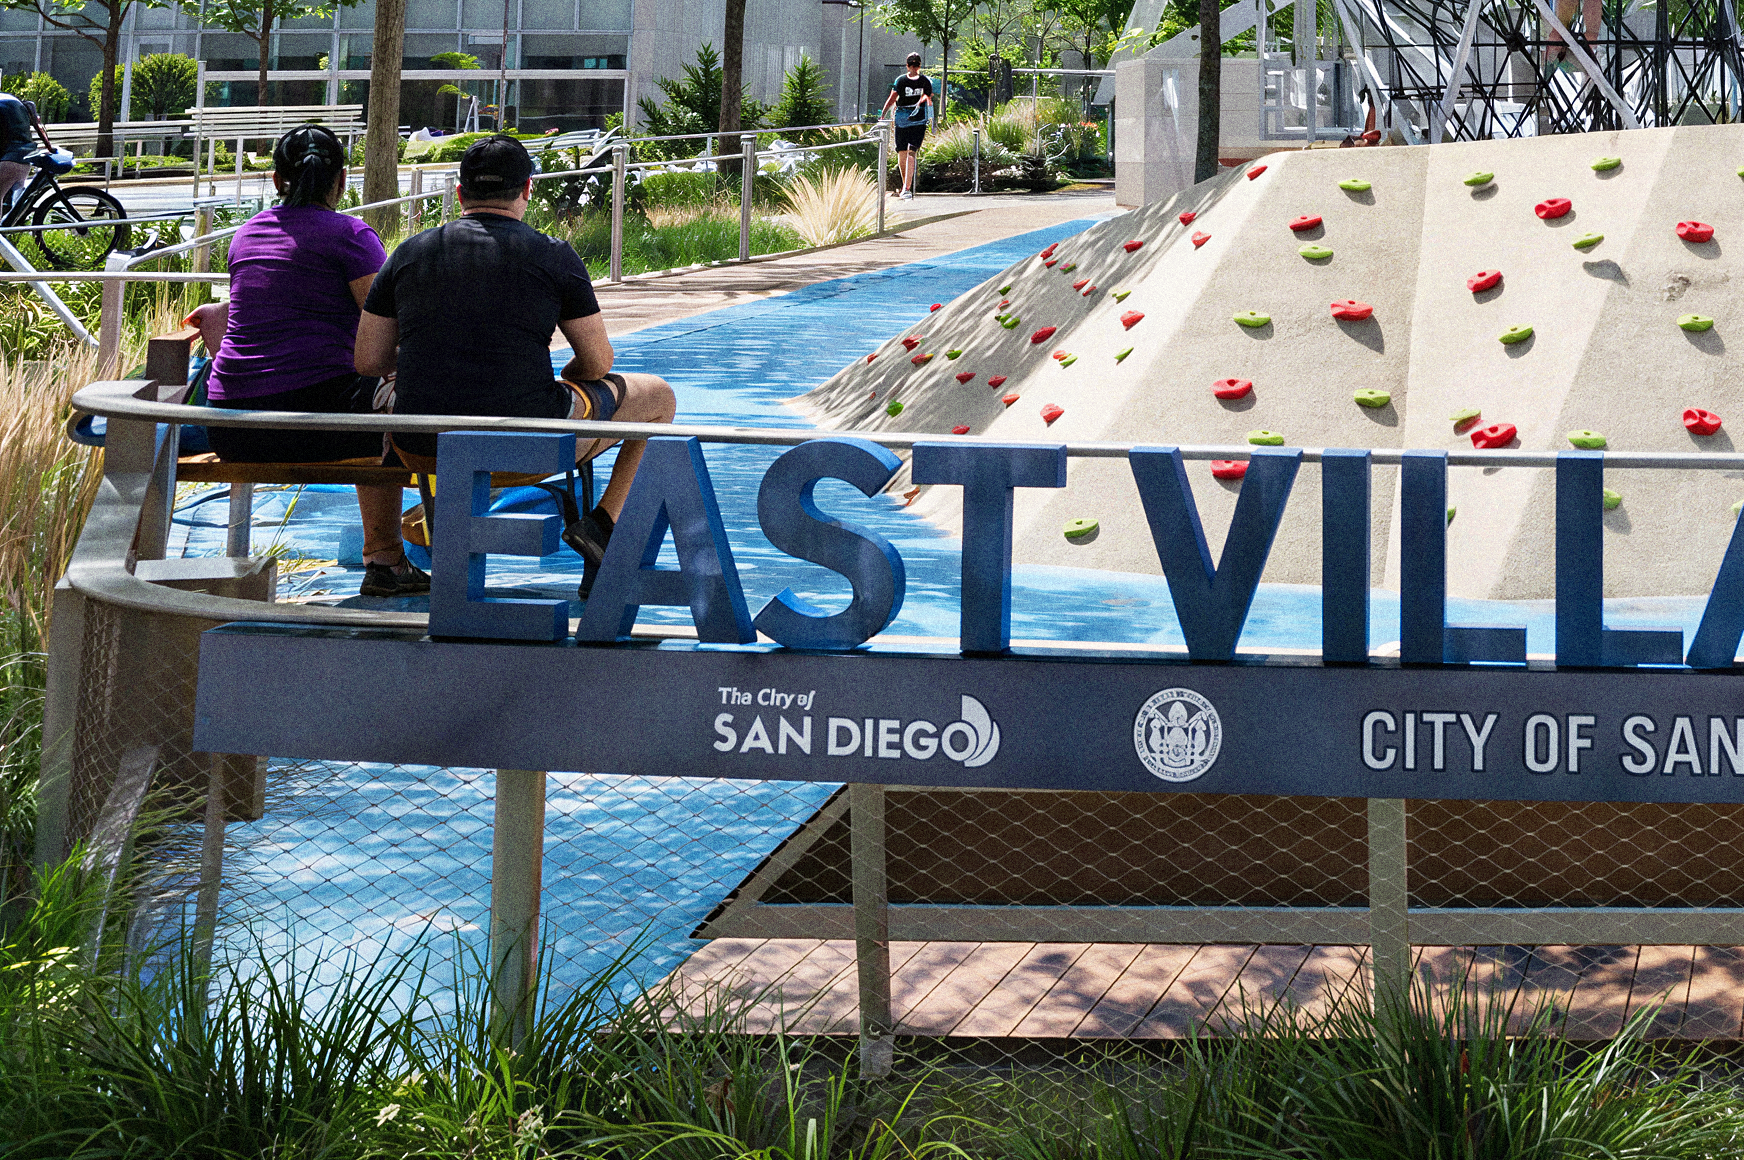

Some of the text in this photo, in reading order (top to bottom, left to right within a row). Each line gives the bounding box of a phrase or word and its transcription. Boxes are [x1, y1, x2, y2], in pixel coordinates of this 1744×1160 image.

[428, 430, 1067, 651] EAST
[713, 712, 979, 762] SAN DIEGO
[1362, 710, 1498, 771] CITY
[1524, 714, 1596, 773] OF
